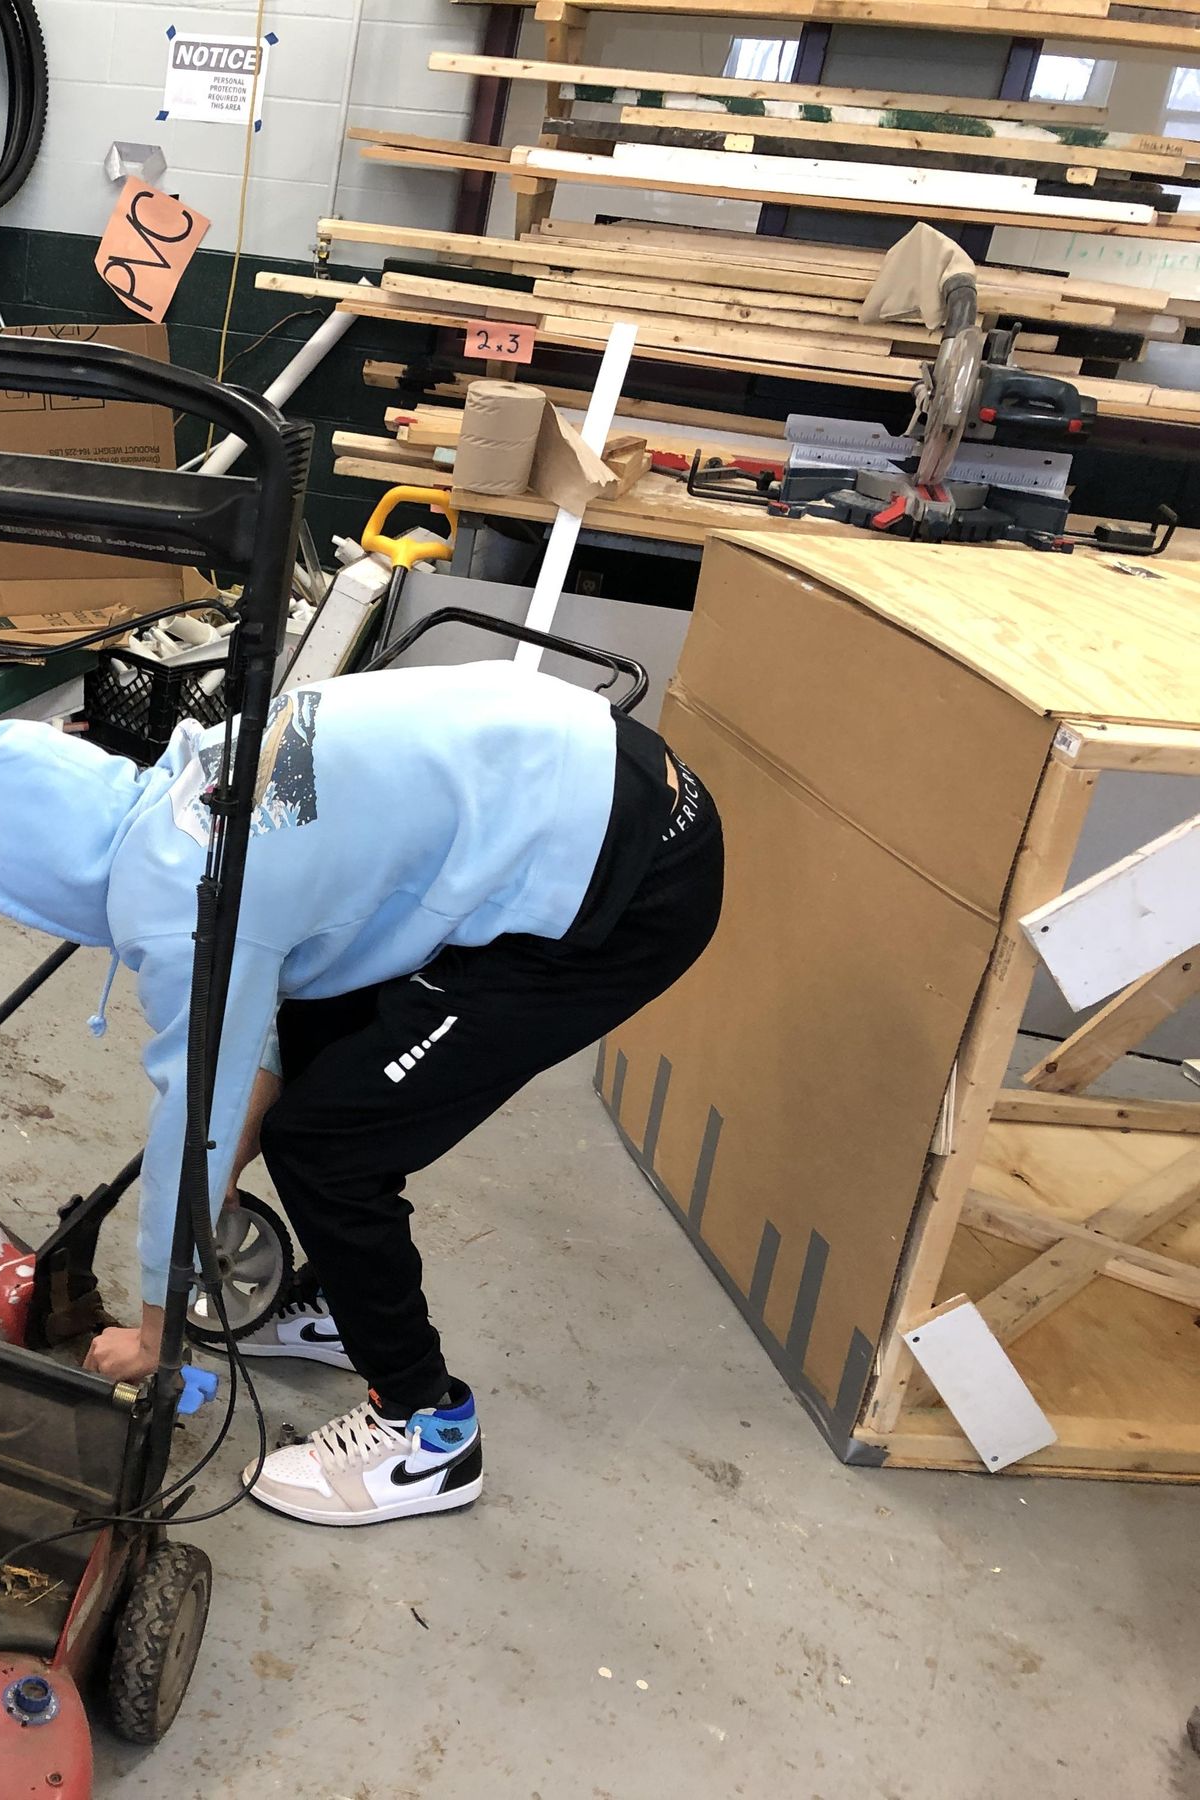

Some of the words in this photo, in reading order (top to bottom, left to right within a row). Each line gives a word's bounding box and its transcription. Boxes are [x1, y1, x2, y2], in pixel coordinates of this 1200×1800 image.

[175, 45, 259, 71] NOTICE
[213, 76, 245, 86] PERSONAL
[209, 85, 247, 94] PROTECTION
[208, 93, 238, 102] REQUIRED
[211, 102, 224, 110] THIS
[103, 191, 193, 312] PVC
[125, 445, 160, 454] PRODUCT
